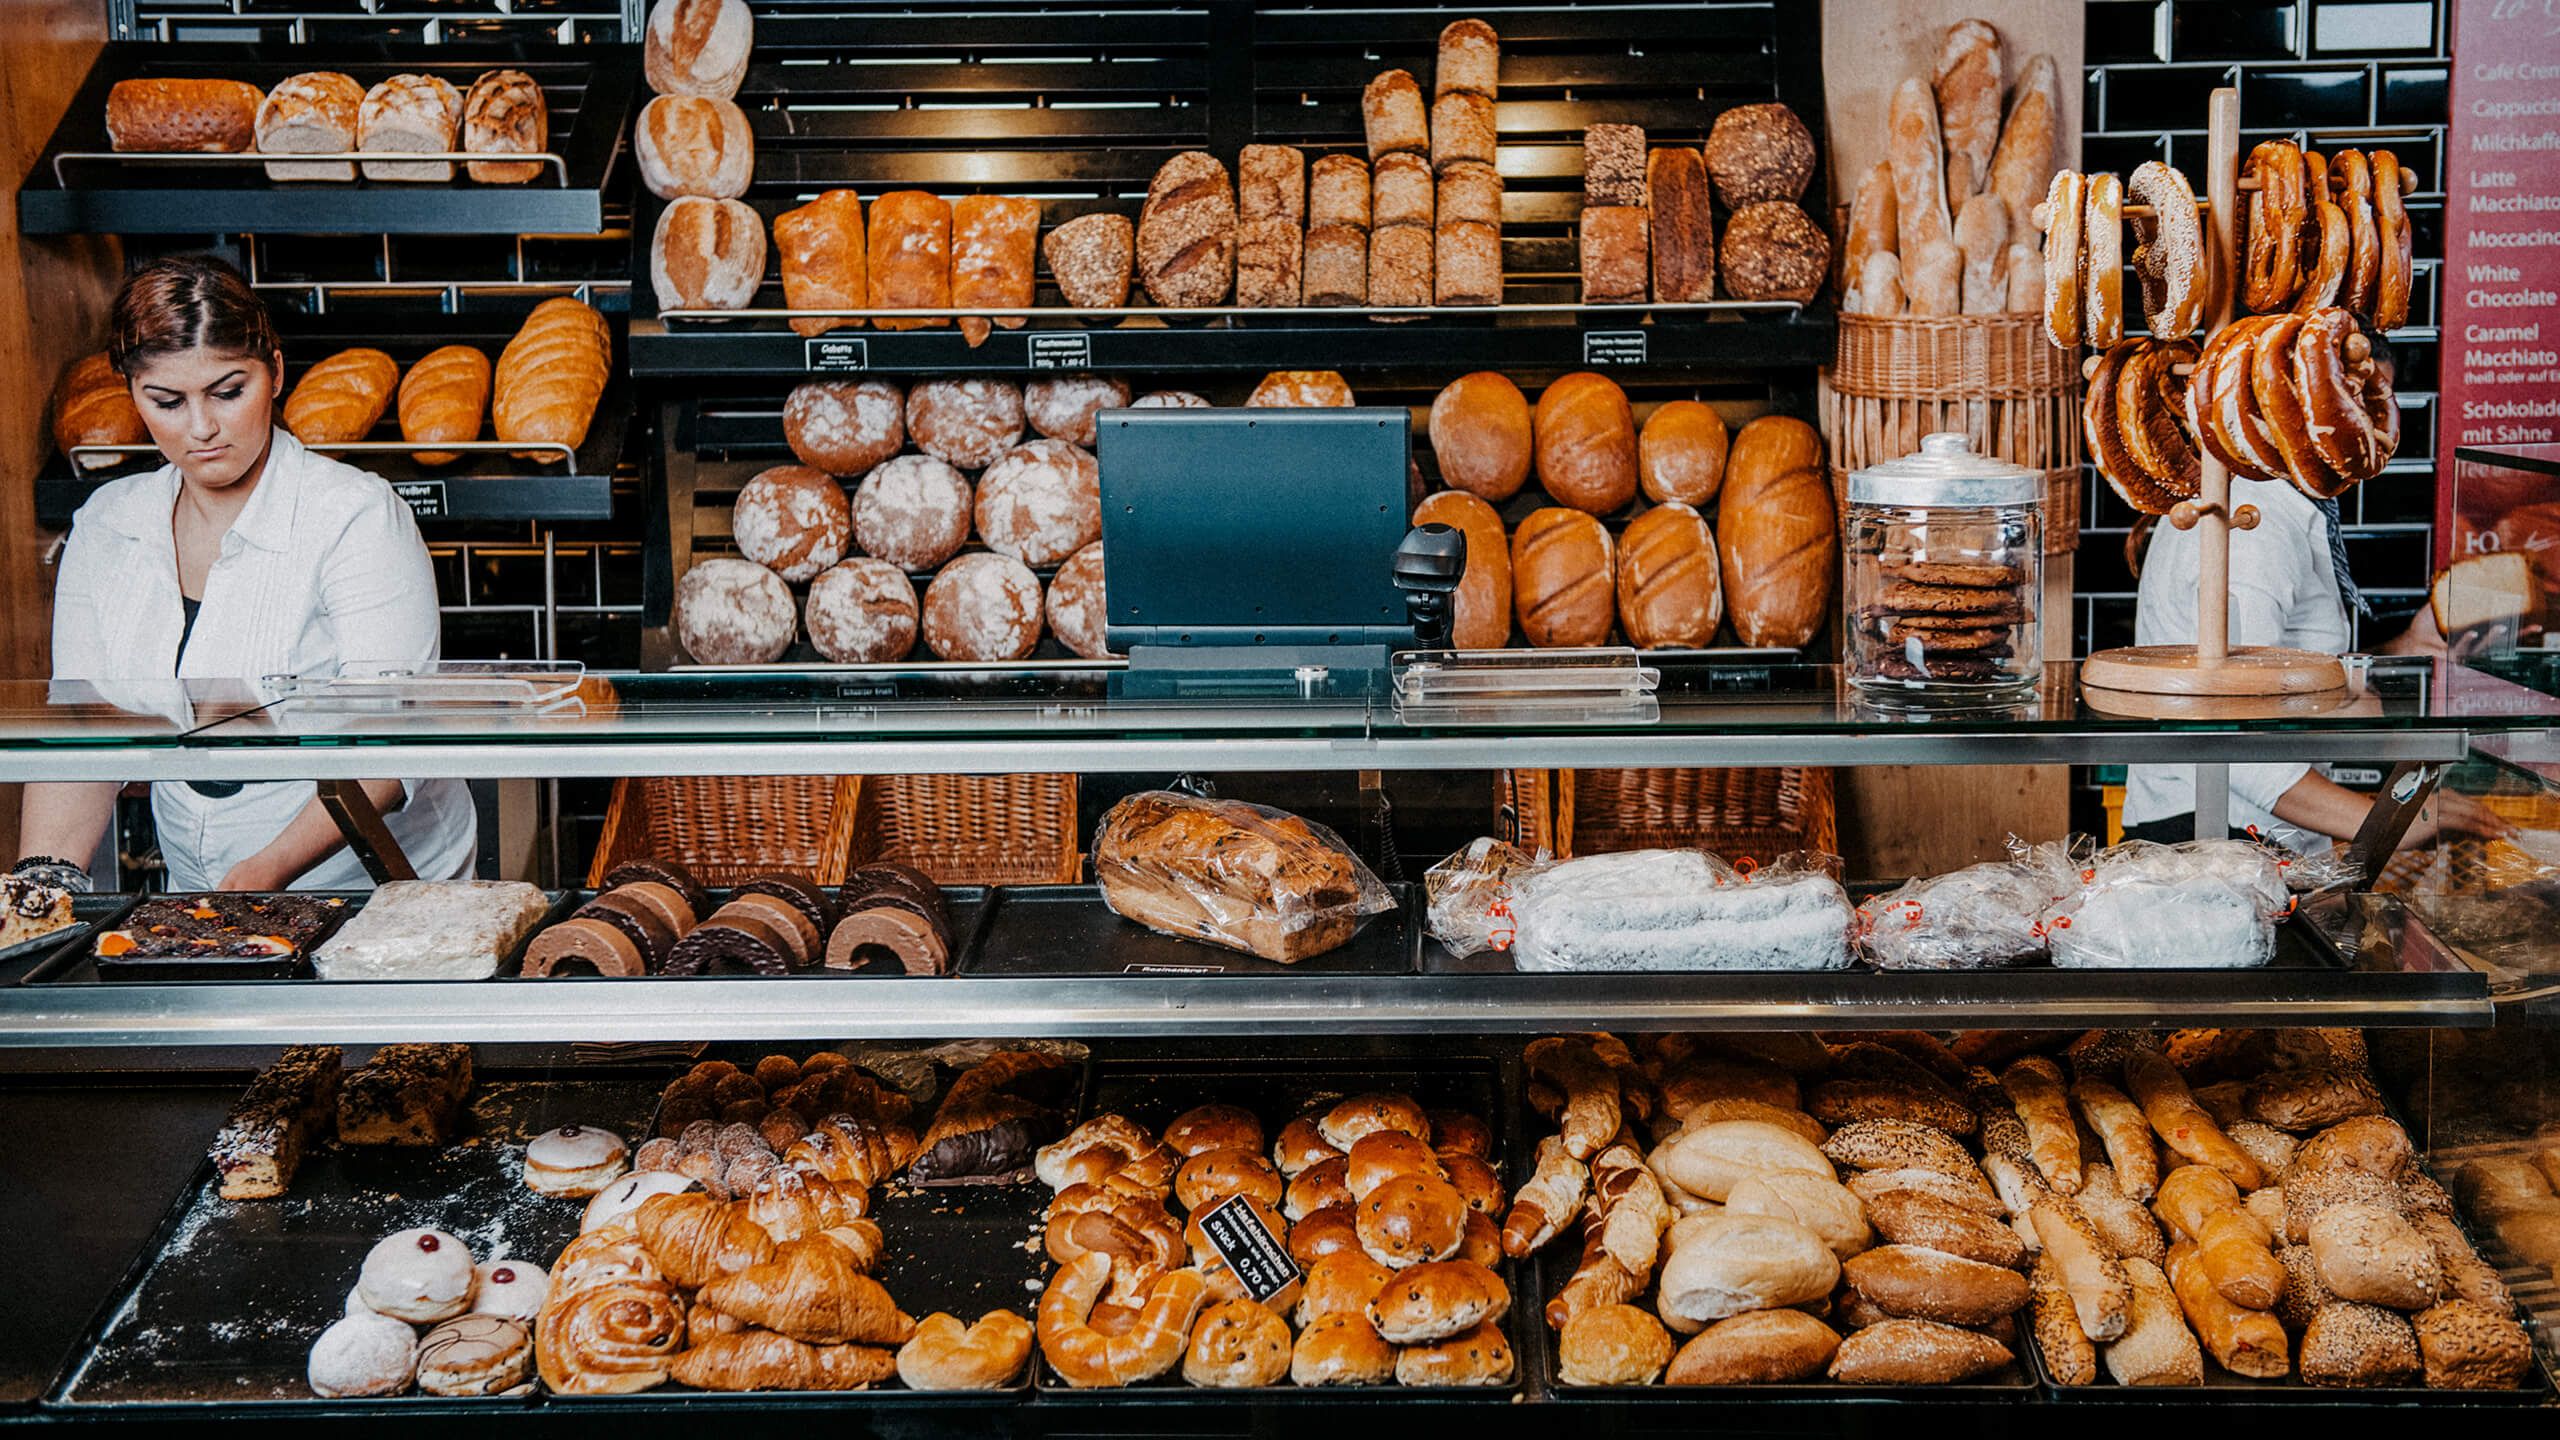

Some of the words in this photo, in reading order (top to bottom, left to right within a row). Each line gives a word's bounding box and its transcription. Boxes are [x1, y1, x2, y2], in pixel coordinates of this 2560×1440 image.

[2470, 170, 2516, 187] Latte
[2469, 193, 2560, 212] Macchiato
[2467, 265, 2520, 282] White
[2465, 288, 2557, 308] Chocolate
[2464, 323, 2539, 342] Caramel
[2464, 350, 2558, 367] Macchiato
[2497, 371, 2525, 383] oder
[2527, 370, 2547, 382] auf
[2463, 425, 2493, 443] mit
[2497, 424, 2552, 442] Sahne
[1211, 1220, 1236, 1251] Stück
[1240, 1258, 1262, 1284] 0.70
[1260, 1284, 1270, 1294] €
